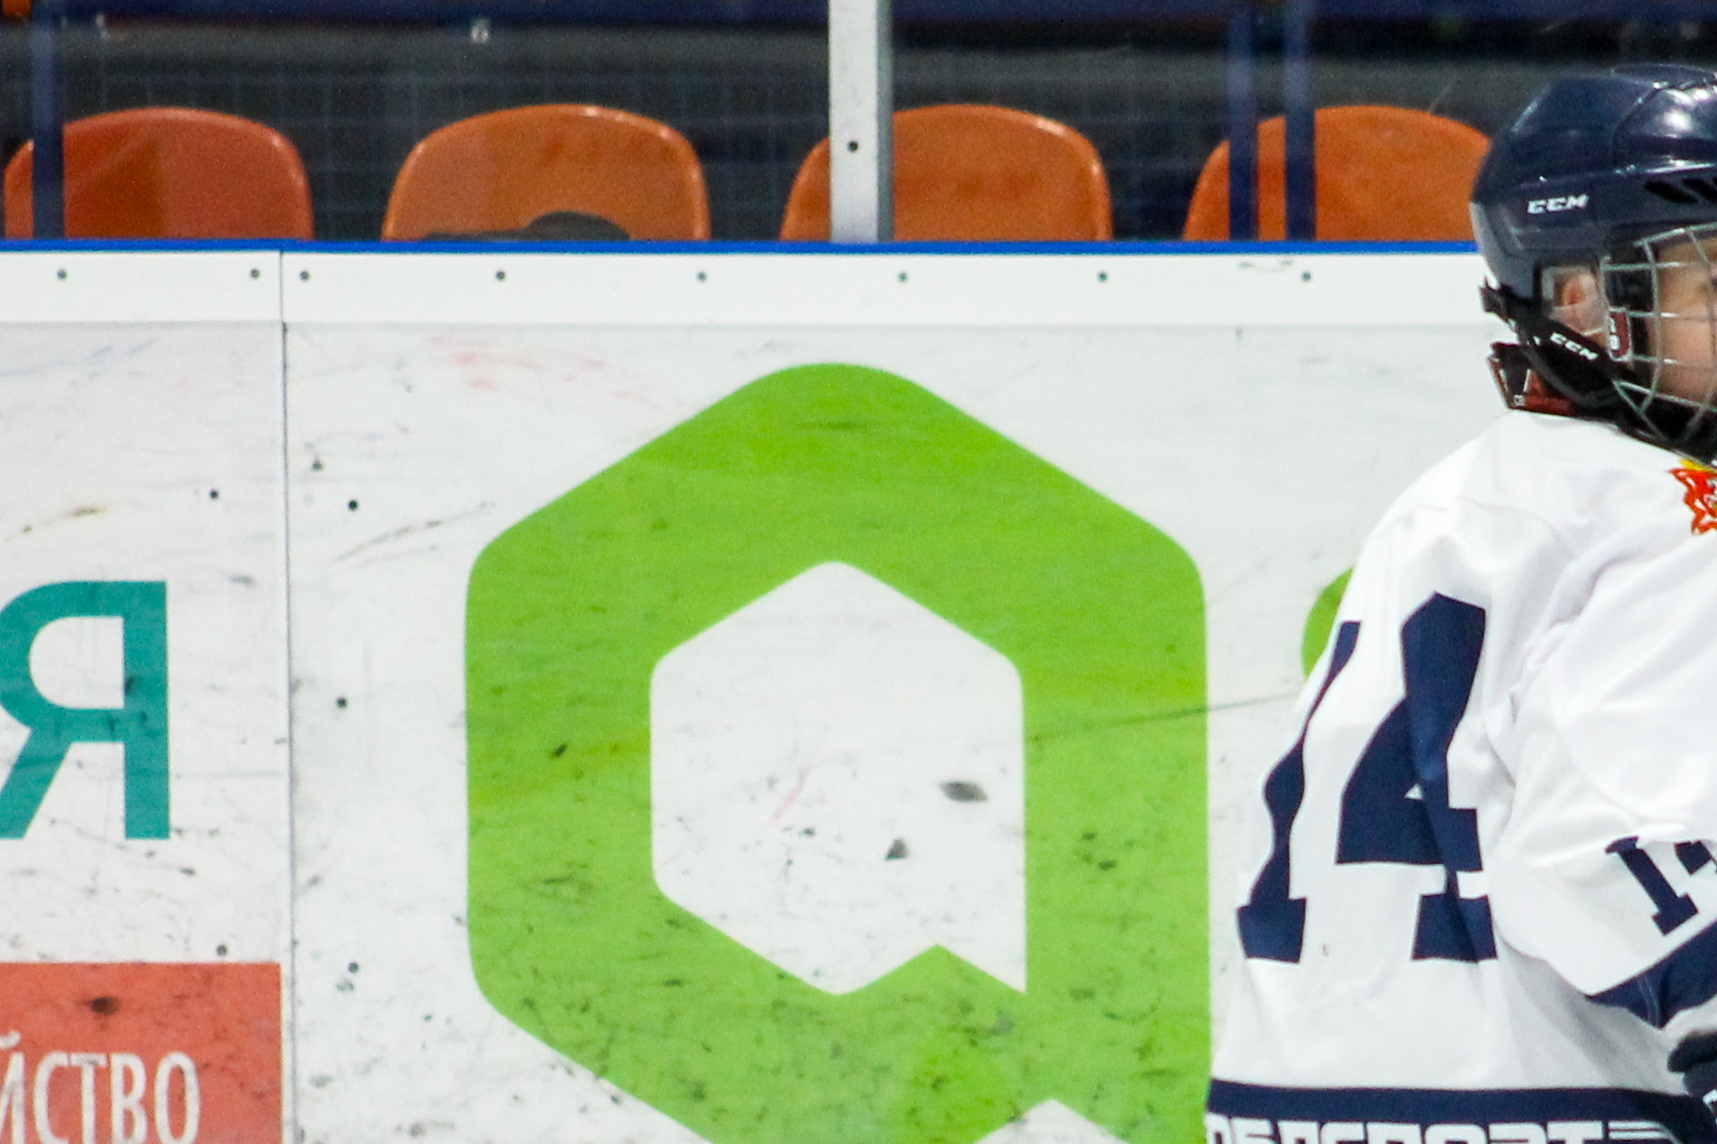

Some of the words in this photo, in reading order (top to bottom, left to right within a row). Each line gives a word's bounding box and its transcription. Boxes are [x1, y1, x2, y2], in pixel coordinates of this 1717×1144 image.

[1527, 194, 1589, 214] CCM
[1550, 332, 1599, 360] CCM
[1237, 591, 1498, 963] 14
